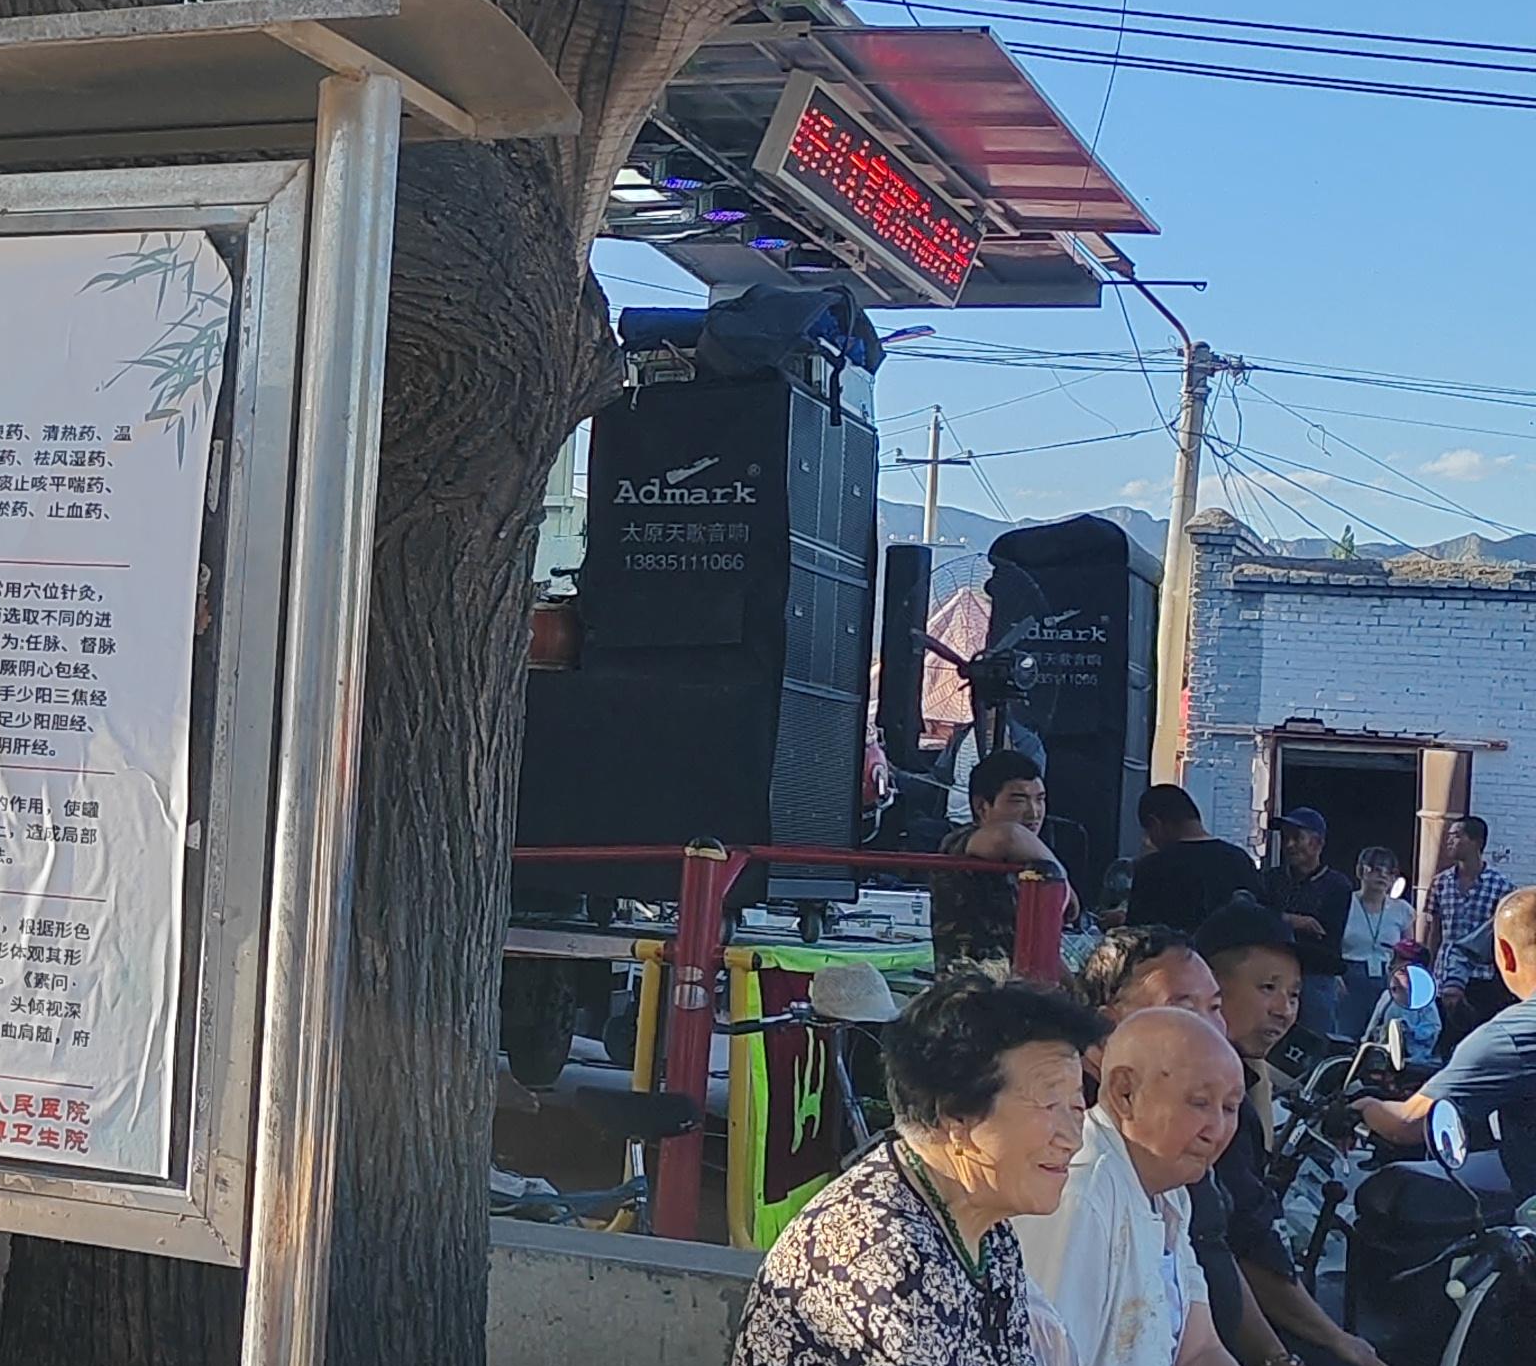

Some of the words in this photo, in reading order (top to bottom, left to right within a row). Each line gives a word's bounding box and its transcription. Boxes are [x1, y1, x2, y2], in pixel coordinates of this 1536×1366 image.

[613, 477, 757, 505] Admark
[624, 553, 745, 571] 13835111066
[1012, 621, 1107, 643] dmark
